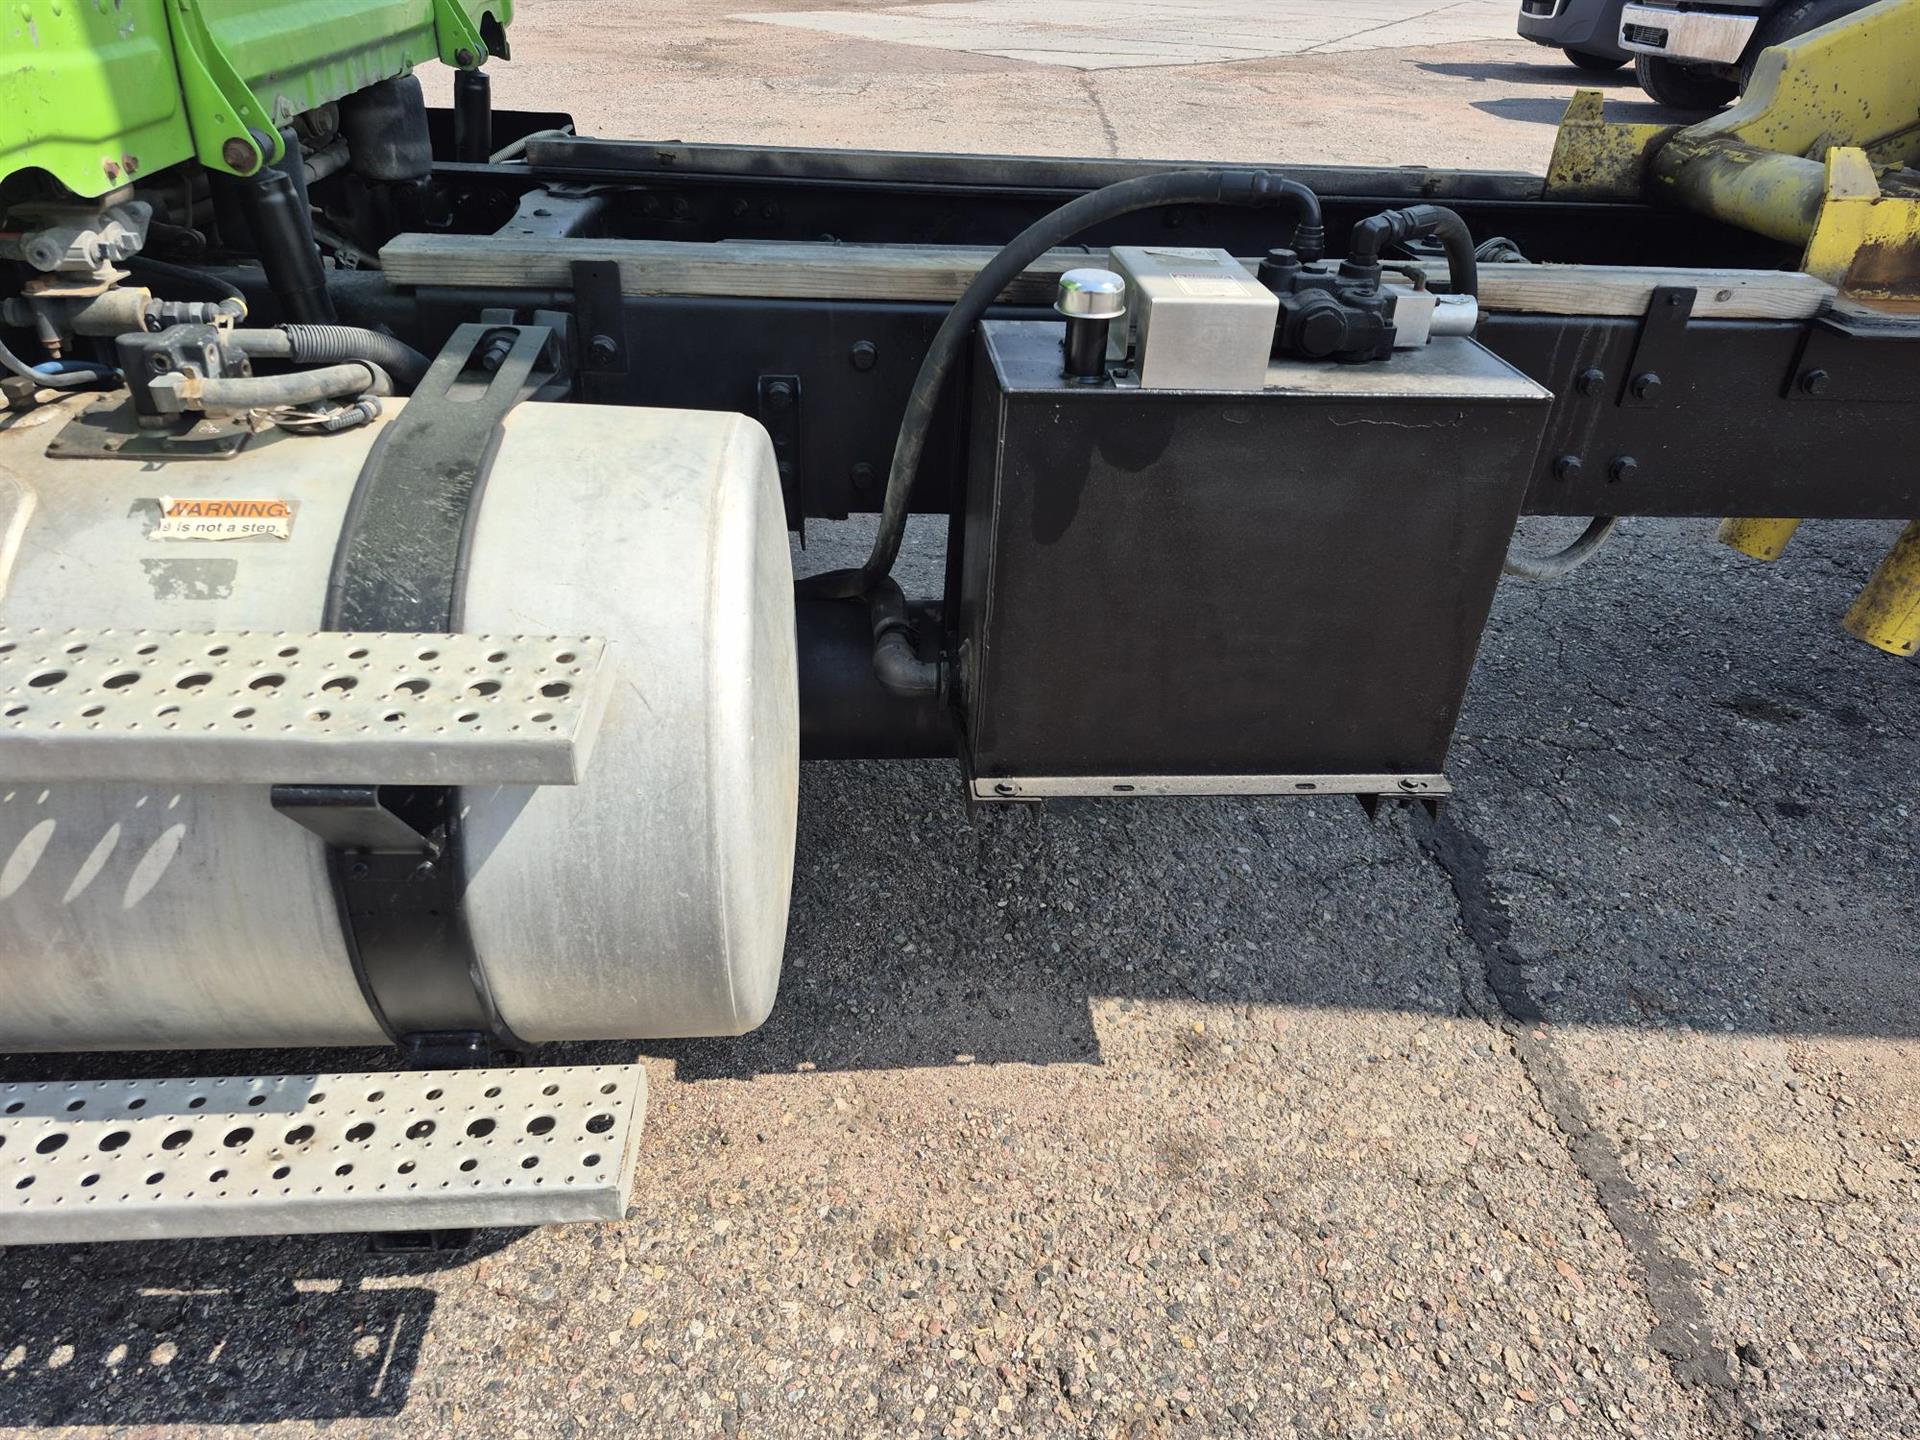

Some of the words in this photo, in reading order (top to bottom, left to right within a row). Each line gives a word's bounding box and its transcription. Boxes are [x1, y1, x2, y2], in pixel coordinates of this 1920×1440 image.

[177, 522, 191, 532] is
[195, 523, 222, 532] not
[226, 524, 236, 532] a
[241, 523, 279, 534] step.
